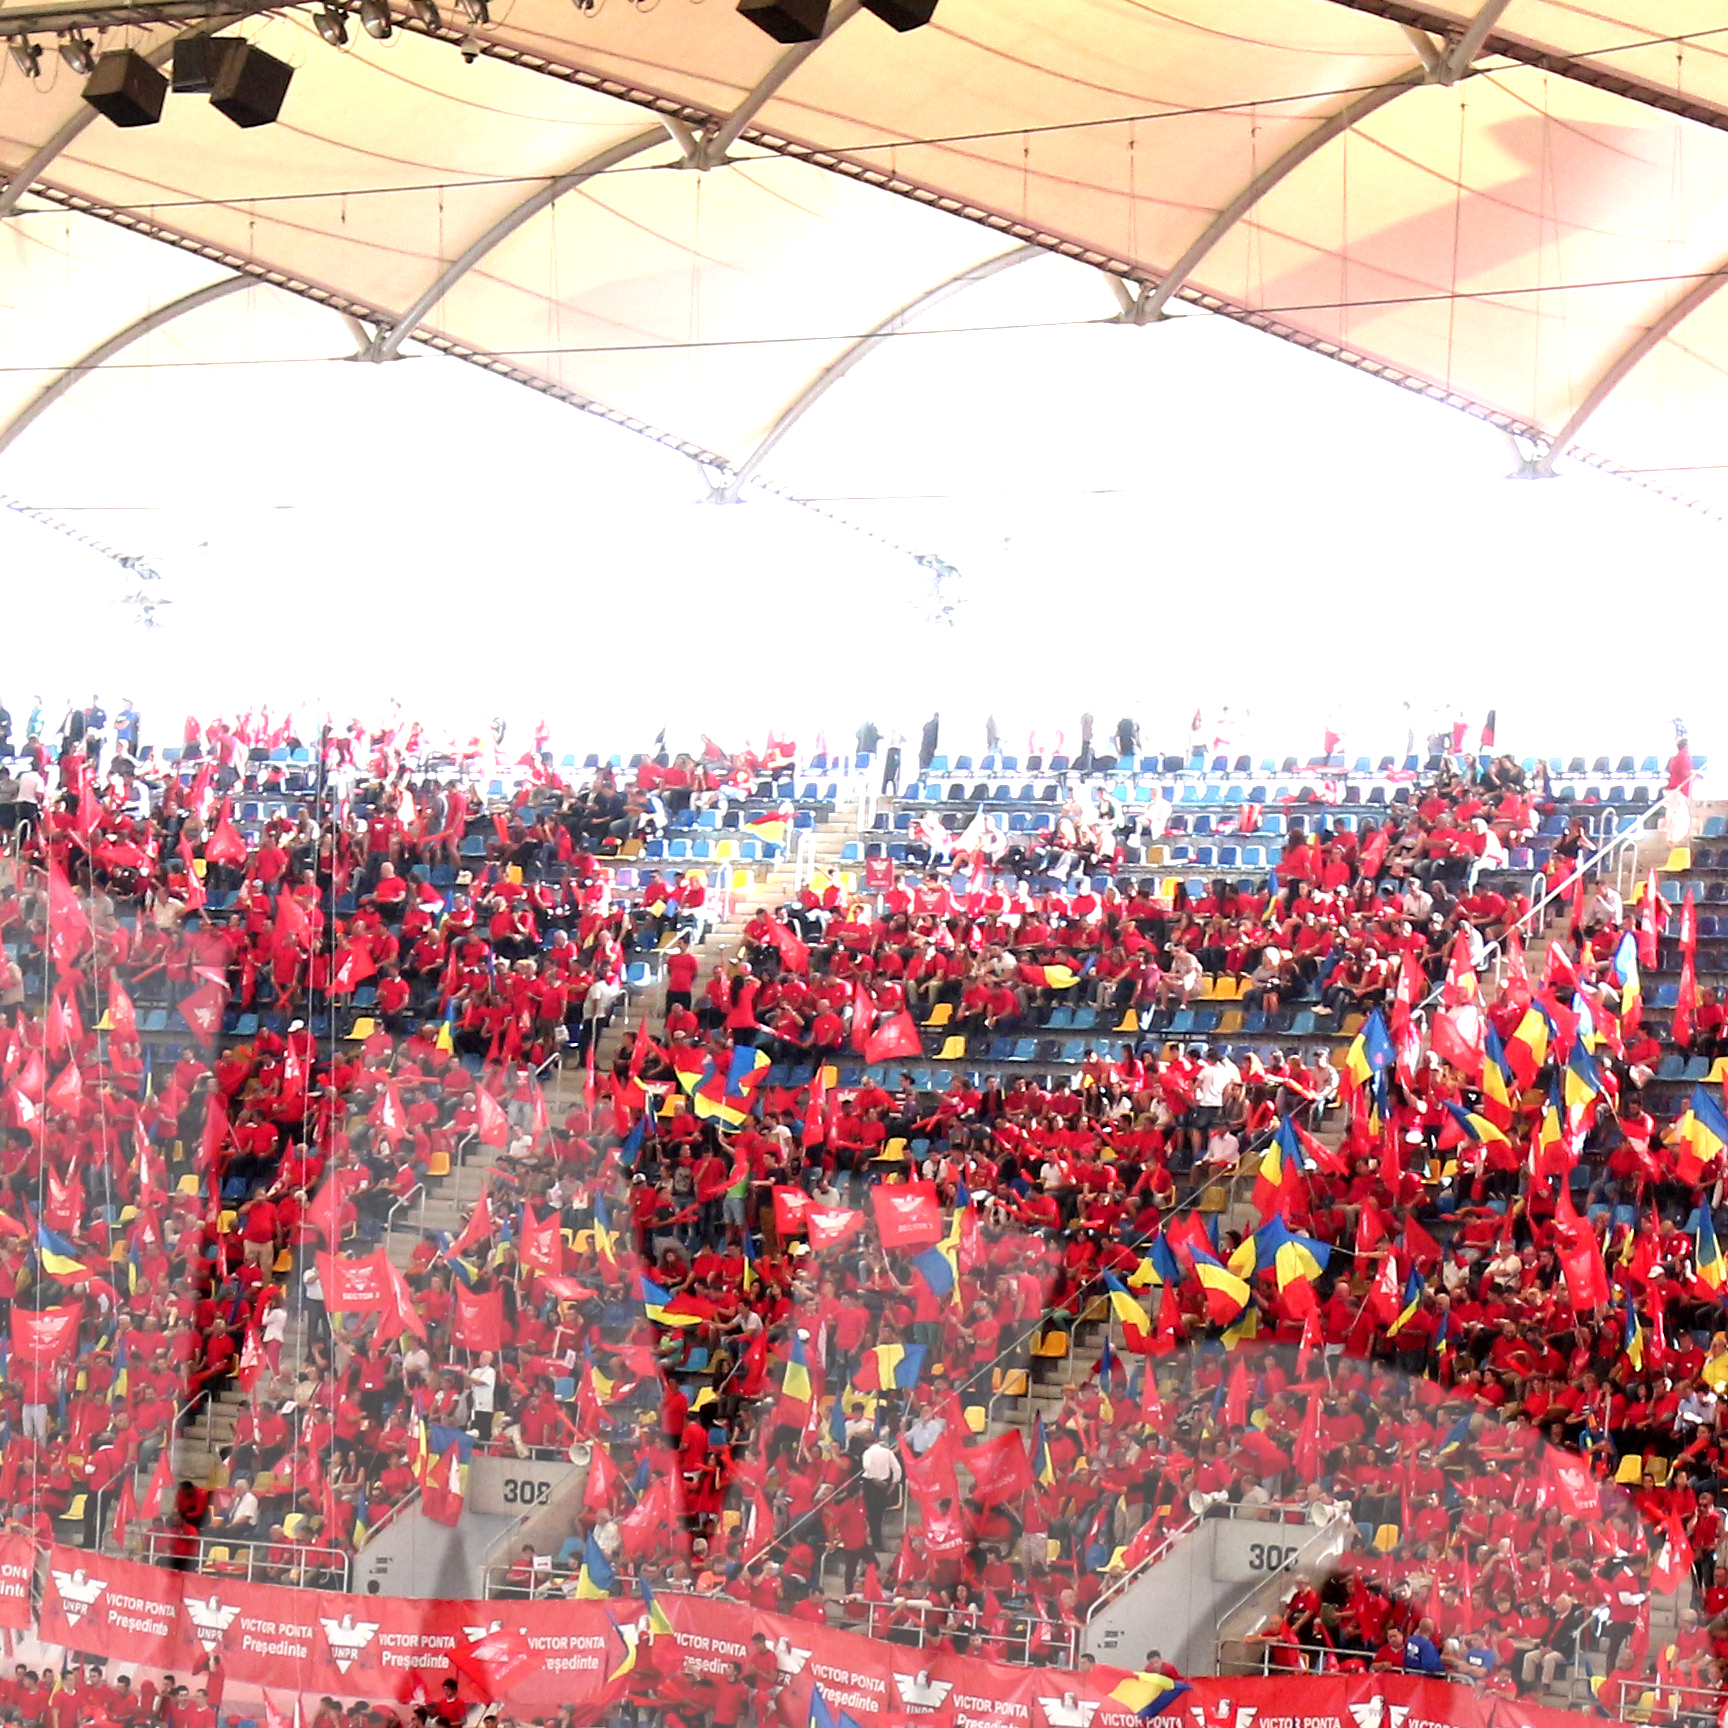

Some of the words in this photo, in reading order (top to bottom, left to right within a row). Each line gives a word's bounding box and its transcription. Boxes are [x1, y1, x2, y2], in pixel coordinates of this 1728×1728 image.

[63, 1600, 88, 1614] UNPR
[106, 1593, 144, 1613] VICTOR
[144, 1601, 176, 1617] PONTA
[107, 1609, 169, 1636] Președinte
[240, 1617, 276, 1635] VICTOR
[277, 1622, 313, 1639] PONTA
[197, 1627, 222, 1641] UNPR
[378, 1633, 420, 1648] VICTOR
[421, 1636, 456, 1649] PONTA
[527, 1636, 569, 1650] VICTOR
[569, 1636, 605, 1649] PONTA
[241, 1635, 308, 1658] Președinte
[331, 1646, 359, 1660] UNPR
[710, 1638, 747, 1657] PONTA
[382, 1650, 450, 1671] Președinte
[811, 1662, 849, 1683] VICTOR
[850, 1672, 886, 1694] PONTA
[953, 1693, 993, 1712] VICTOR
[994, 1700, 1029, 1718] PONTA
